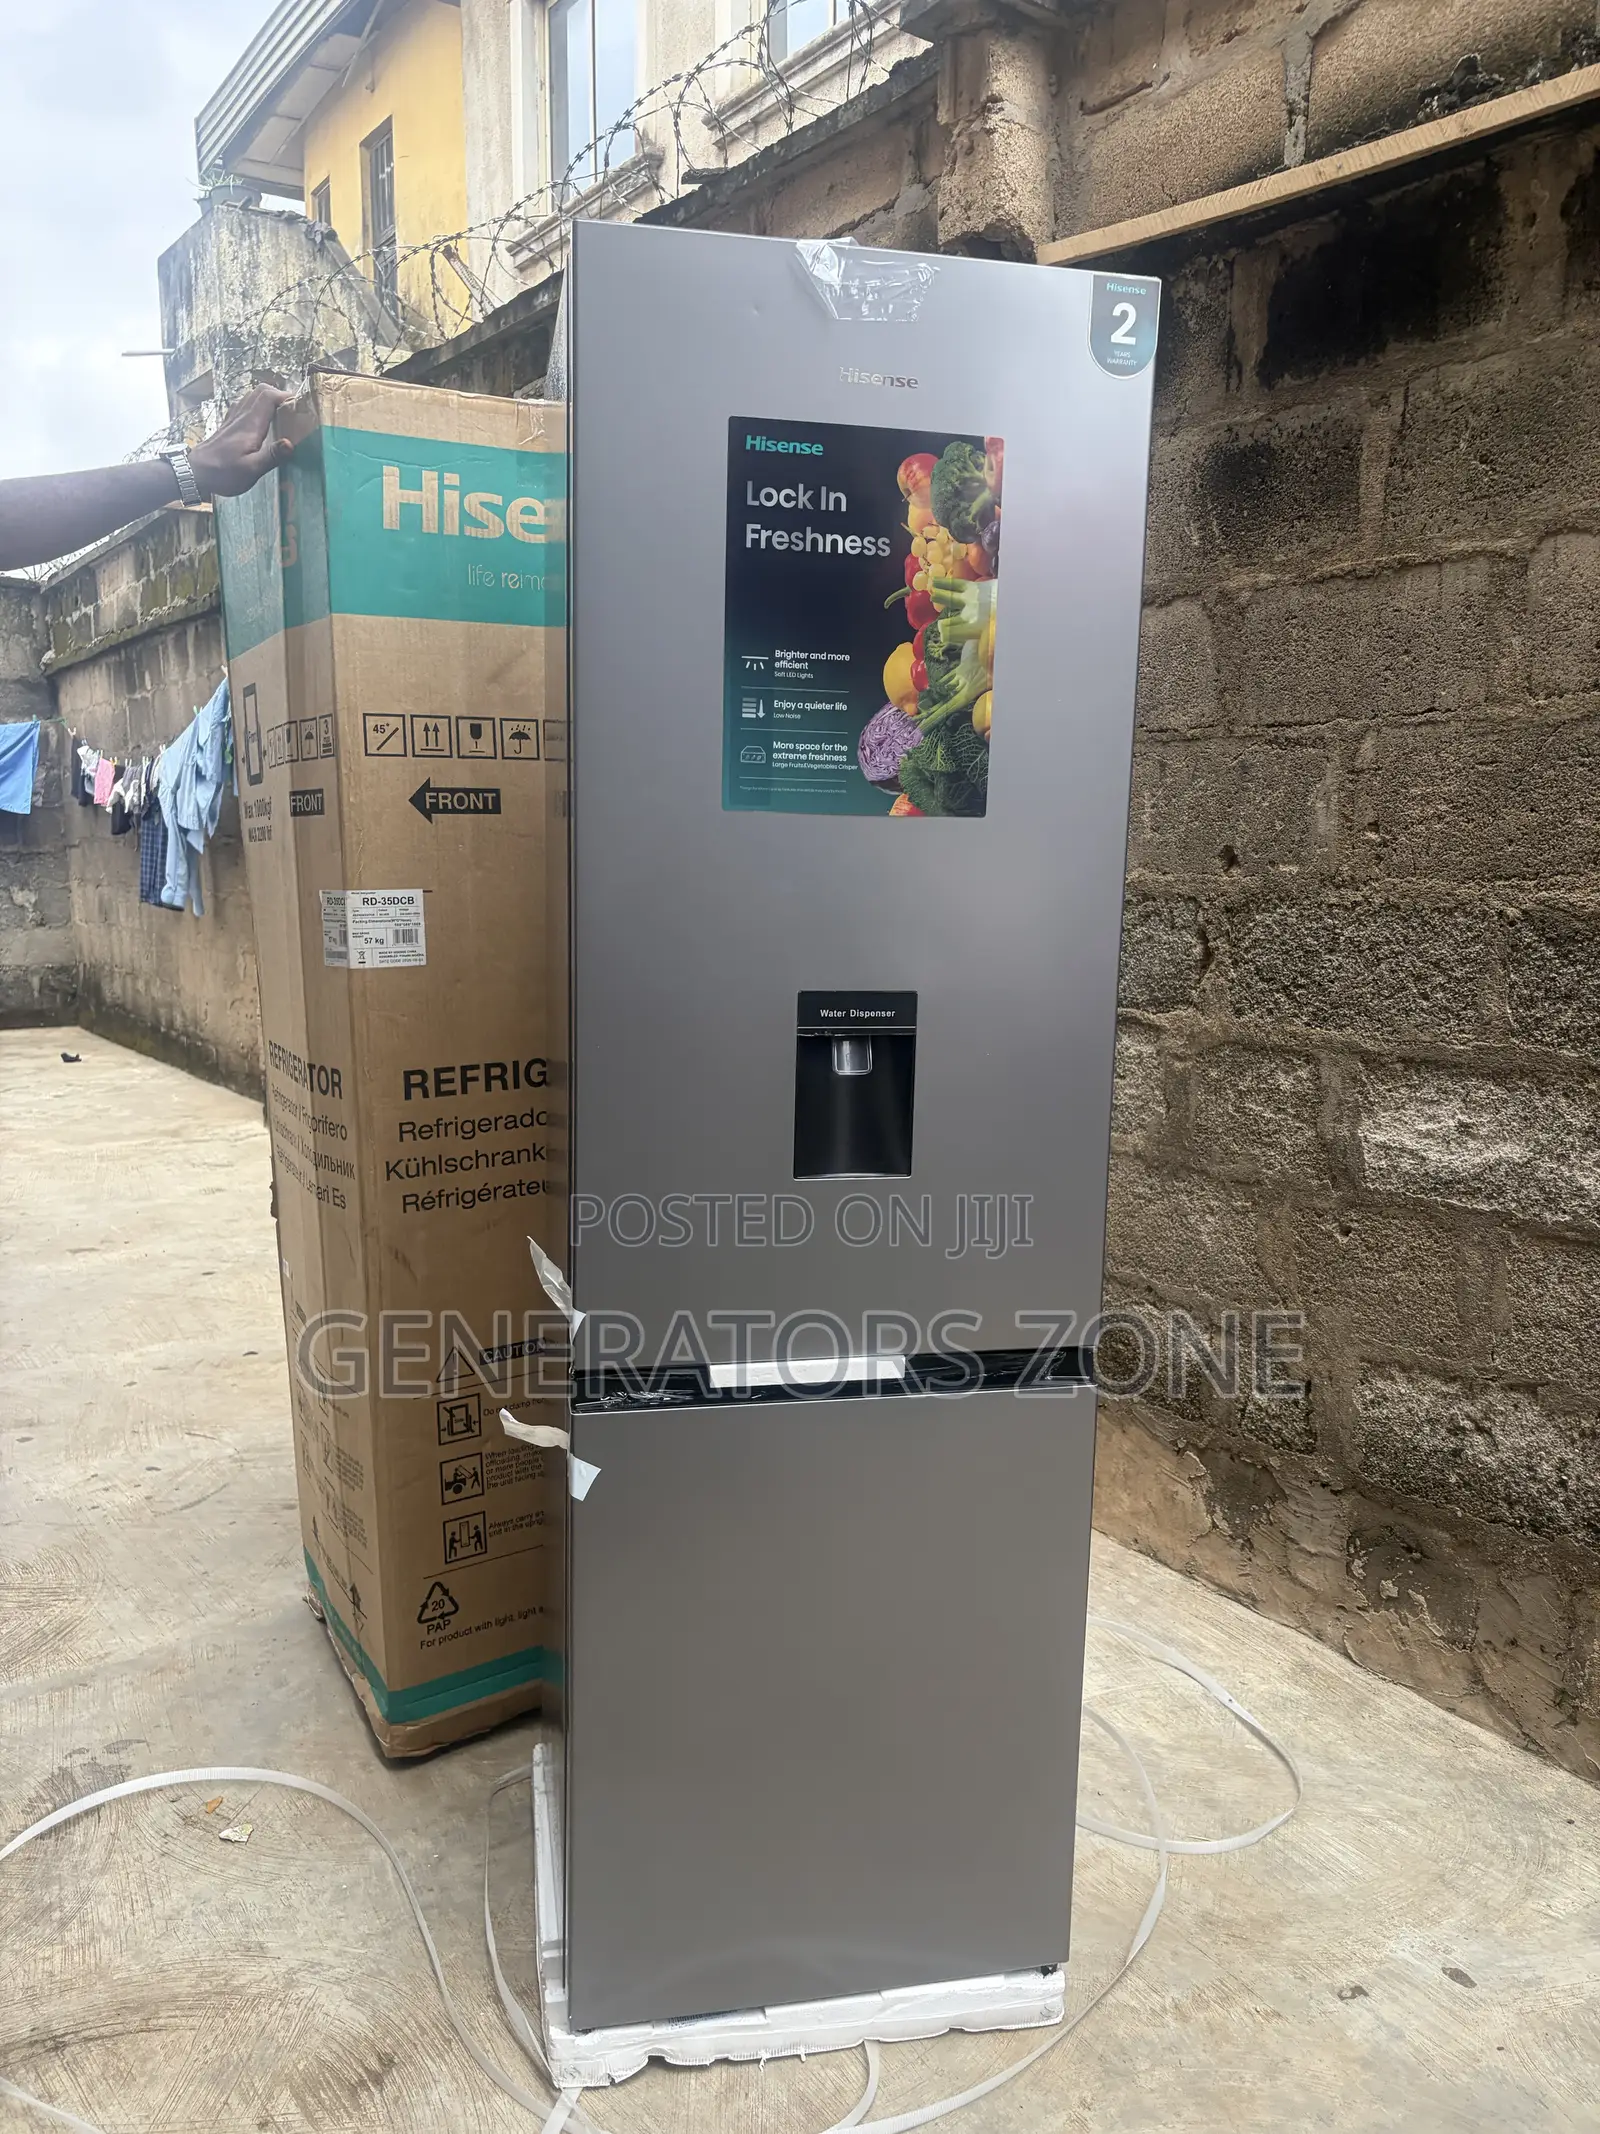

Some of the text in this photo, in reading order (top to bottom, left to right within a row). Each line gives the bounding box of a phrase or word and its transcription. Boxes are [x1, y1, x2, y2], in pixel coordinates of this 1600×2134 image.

[1106, 282, 1147, 295] Hisense
[1110, 302, 1137, 346] 2
[839, 366, 919, 389] Hisense
[745, 435, 824, 456] Hisense
[746, 480, 847, 512] Lock In
[745, 523, 891, 557] Freshness
[468, 563, 495, 587] life
[774, 649, 850, 661] Brighter and more
[774, 660, 809, 670] efficient
[773, 699, 796, 711] Enjoy
[804, 701, 835, 711] quieter
[834, 702, 848, 711] life
[773, 741, 848, 752] More space for the
[772, 752, 847, 762] extreme freshness
[290, 793, 323, 813] FRONT
[424, 792, 497, 811] FRONT
[362, 896, 415, 907] RD-35DCB
[364, 937, 373, 945] 57
[375, 937, 384, 946] kg
[820, 1009, 895, 1019] Water Dispenser
[269, 1039, 343, 1100] REFRIGERATOR
[403, 1057, 548, 1101] REFRIG
[385, 1142, 546, 1182] Kühlschrank
[482, 1338, 546, 1364] CAUTION
[483, 1408, 495, 1417] Do
[431, 1598, 446, 1612] 20
[420, 1638, 437, 1650] For
[438, 1626, 473, 1646] product
[474, 1621, 493, 1632] with
[517, 1607, 537, 1619] light
[426, 1619, 451, 1635] PAP
